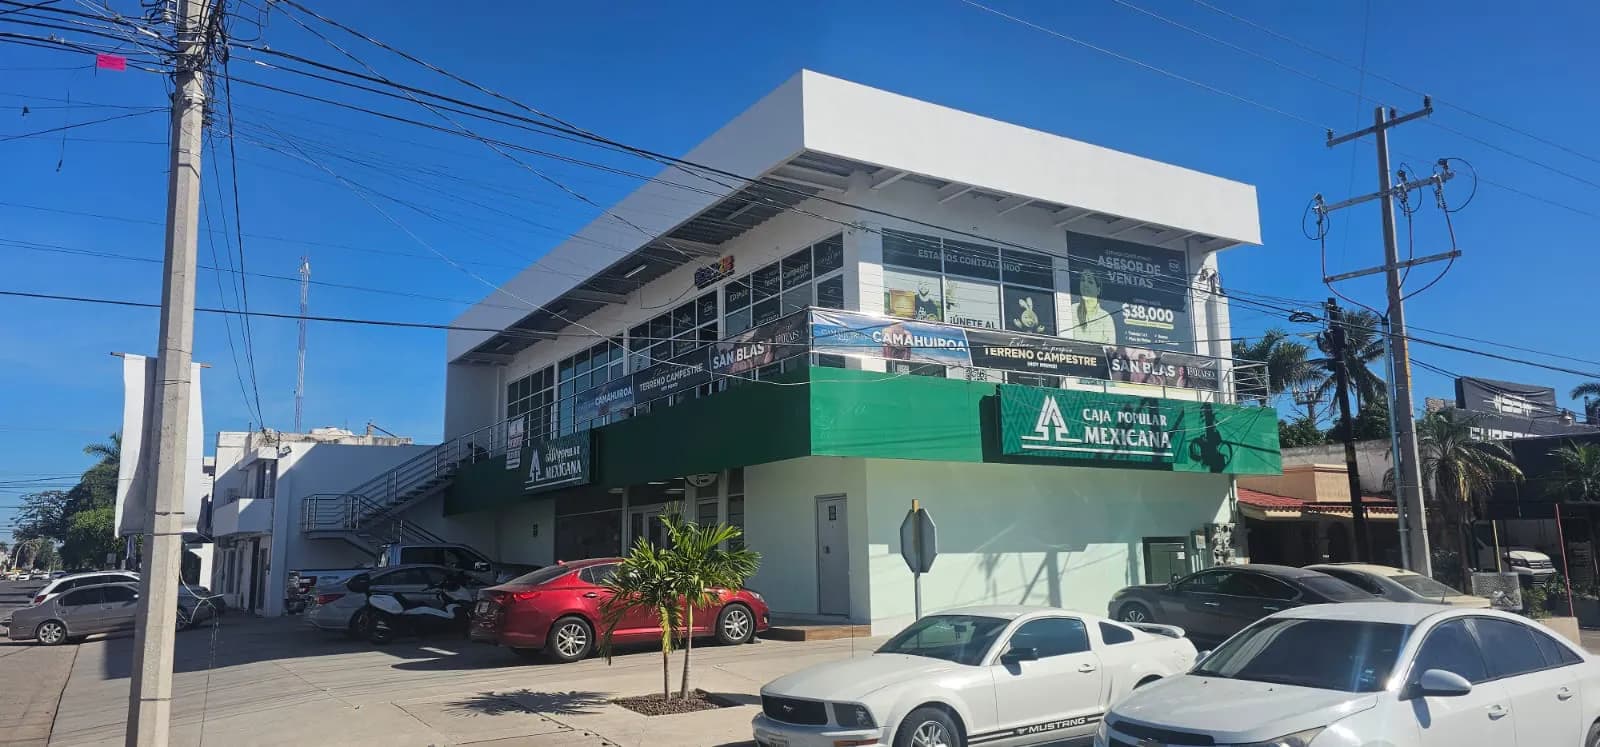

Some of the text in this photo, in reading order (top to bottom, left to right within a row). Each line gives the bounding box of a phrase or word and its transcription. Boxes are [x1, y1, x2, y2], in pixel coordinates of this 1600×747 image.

[1096, 255, 1144, 273] ASESOR
[1146, 263, 1161, 275] DE
[1109, 271, 1154, 289] VENTAS
[1122, 303, 1174, 322] $38,000
[985, 320, 997, 329] AL
[872, 331, 966, 352] CAMAHUIROA
[713, 341, 765, 369] SAN BLAS
[984, 347, 1097, 366] TERRENO CAMPESTRE
[639, 376, 666, 392] TERRENO
[666, 362, 704, 383] CAMPESTRE
[1112, 358, 1176, 377] SAN BLAS
[594, 386, 632, 406] CAMAHUIROA
[1083, 408, 1167, 426] CAJA POPULAR
[1084, 426, 1172, 448] MEXICANA
[545, 459, 582, 479] MEXICANA
[1028, 717, 1086, 733] MUSTANG
